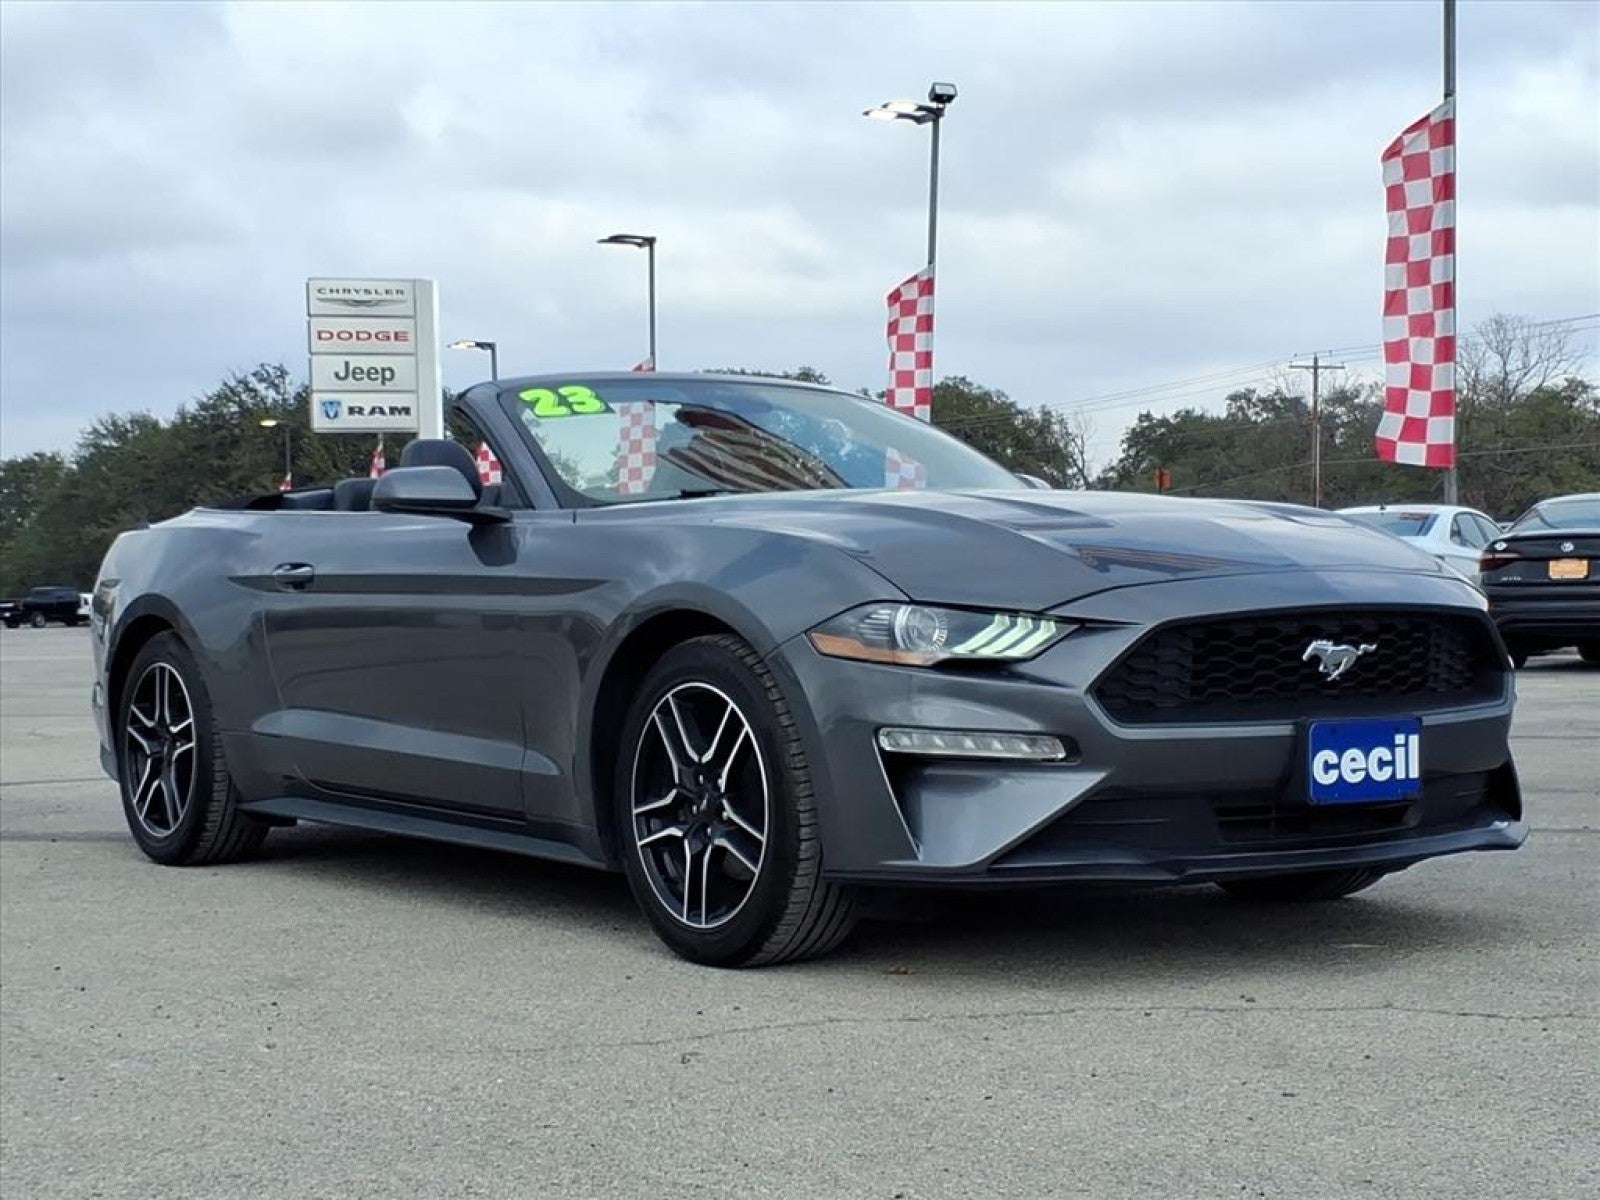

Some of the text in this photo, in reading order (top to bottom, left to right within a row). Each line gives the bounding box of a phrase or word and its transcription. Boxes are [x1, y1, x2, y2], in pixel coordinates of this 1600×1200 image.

[316, 287, 405, 296] CHRYSLER
[317, 330, 410, 342] DODGE
[333, 361, 396, 386] Jeep
[519, 385, 606, 417] 23
[347, 405, 412, 417] RAM
[1312, 733, 1420, 785] cecil
